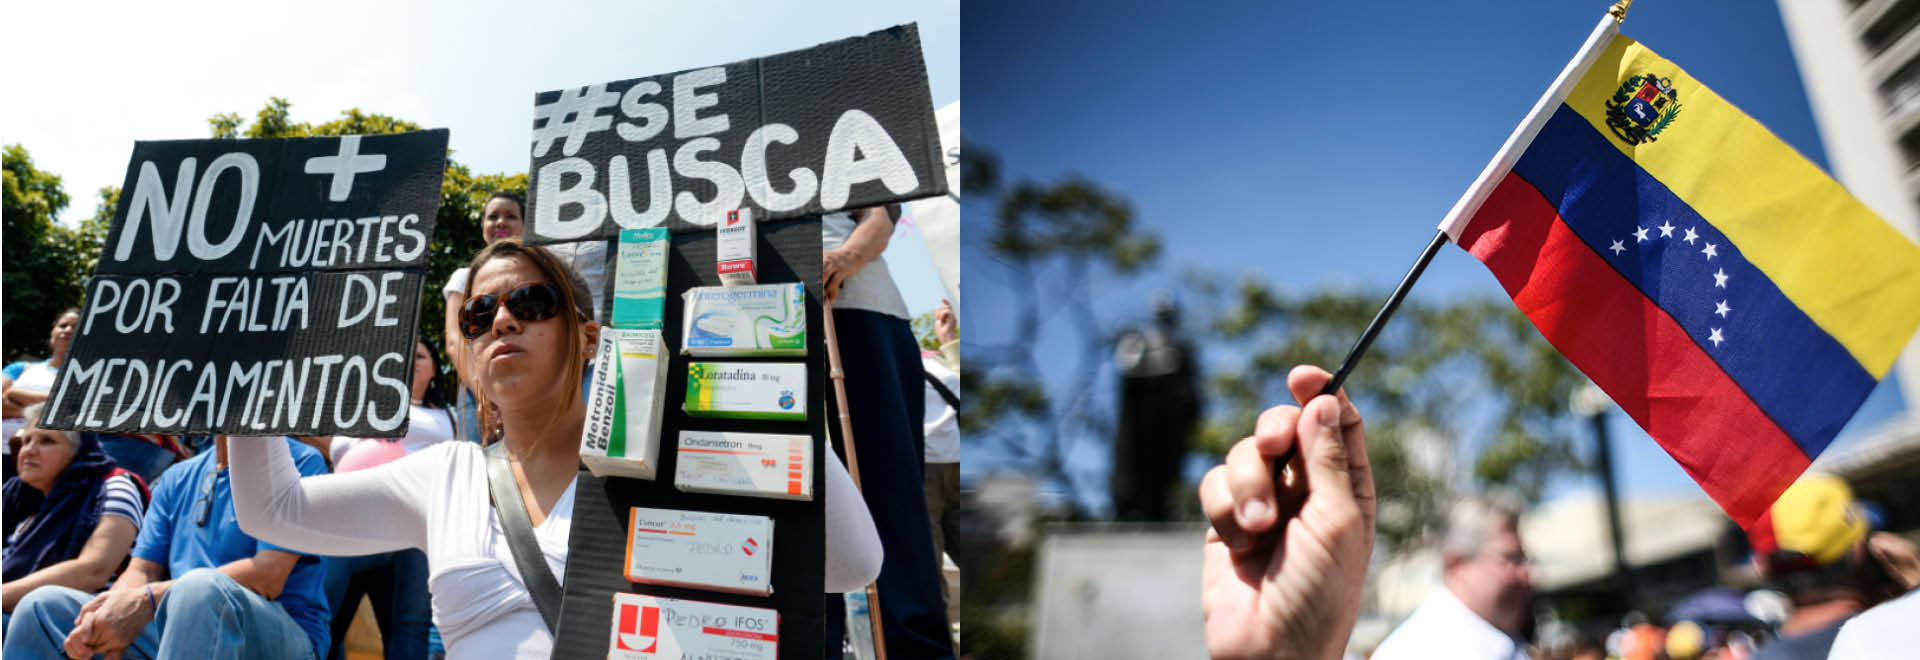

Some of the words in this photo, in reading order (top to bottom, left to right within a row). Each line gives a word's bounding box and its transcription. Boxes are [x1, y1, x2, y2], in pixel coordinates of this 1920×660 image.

[532, 66, 730, 158] #SE
[533, 108, 919, 239] BUSCA
[114, 152, 260, 262] NO
[250, 214, 427, 270] MUERTES
[83, 279, 182, 335] POR
[200, 277, 309, 334] FALTA
[337, 272, 404, 329] DE
[46, 352, 411, 432] MEDICAMENTOS
[586, 338, 614, 450] Metronidazol
[701, 368, 756, 382] Loratadina
[597, 384, 617, 451] Benzoil
[684, 437, 743, 449] Ondansetron
[730, 638, 748, 650] 750
[750, 643, 764, 651] mg
[735, 616, 766, 632] IFOS
